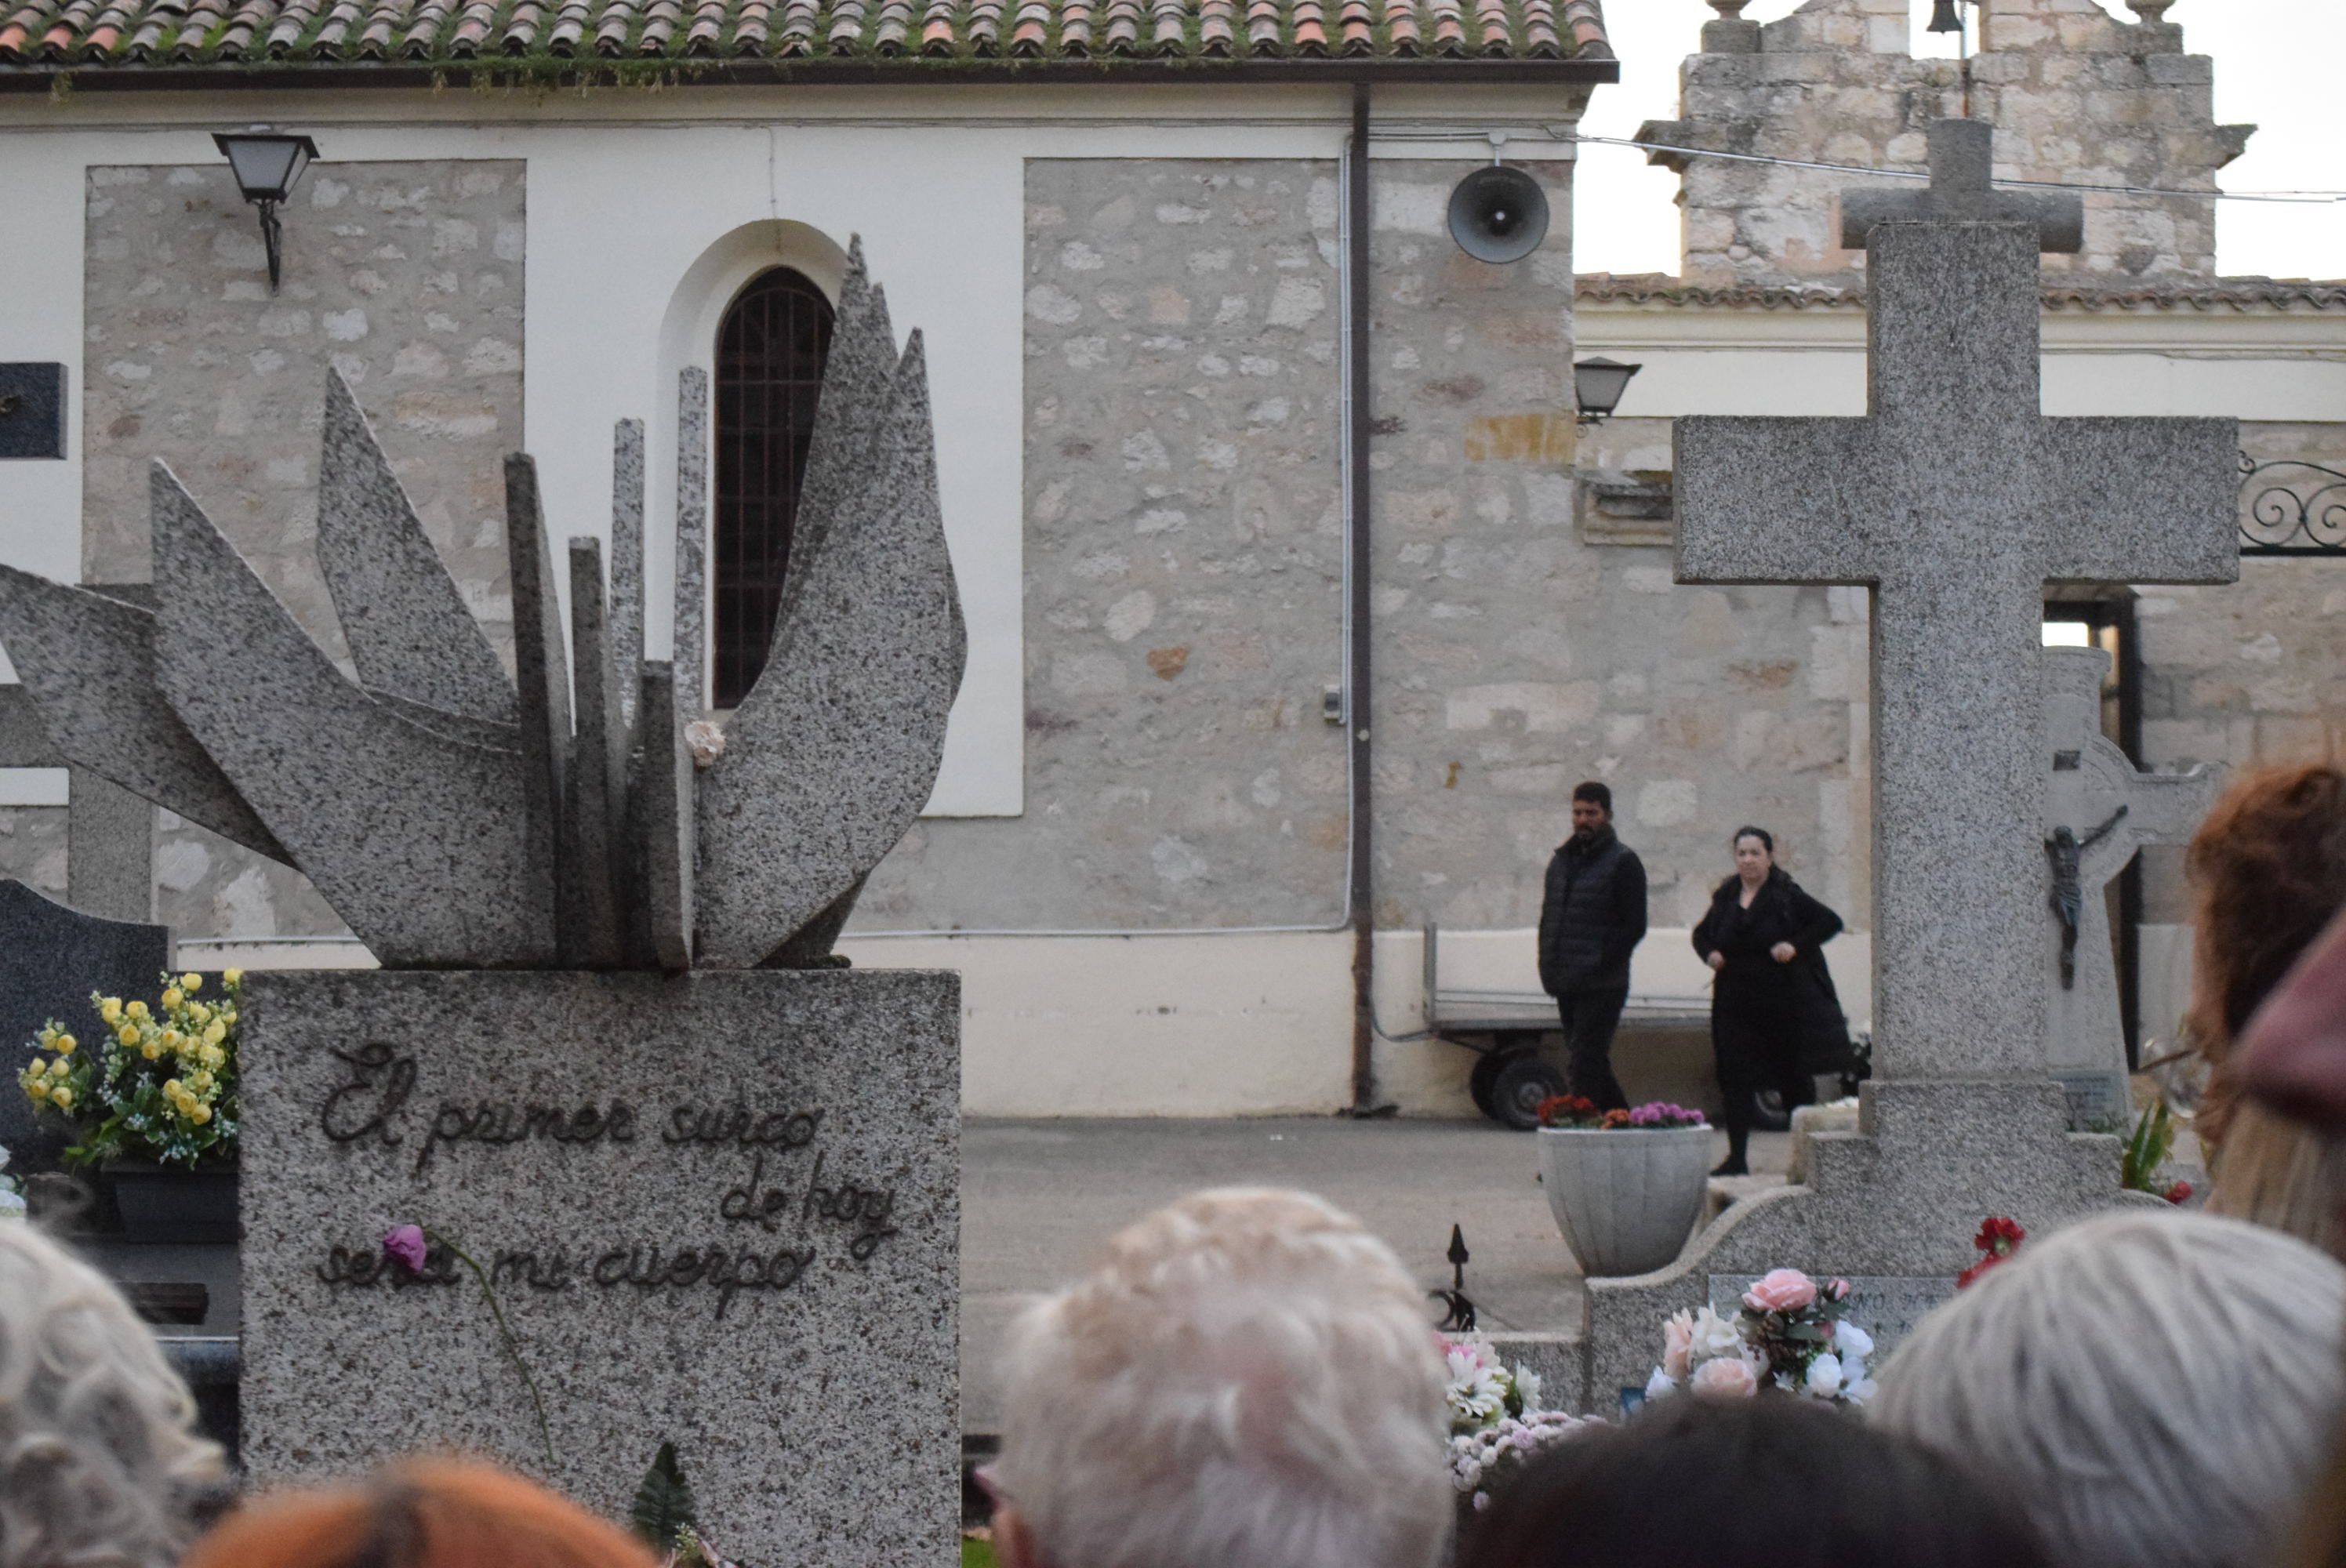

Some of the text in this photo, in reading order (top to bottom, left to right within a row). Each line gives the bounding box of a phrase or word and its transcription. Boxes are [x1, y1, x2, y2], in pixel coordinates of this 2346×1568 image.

[322, 1041, 826, 1178] El primer surco
[721, 1149, 899, 1261] de hoy
[489, 1247, 572, 1290] mi
[594, 1242, 816, 1321] cuerpo
